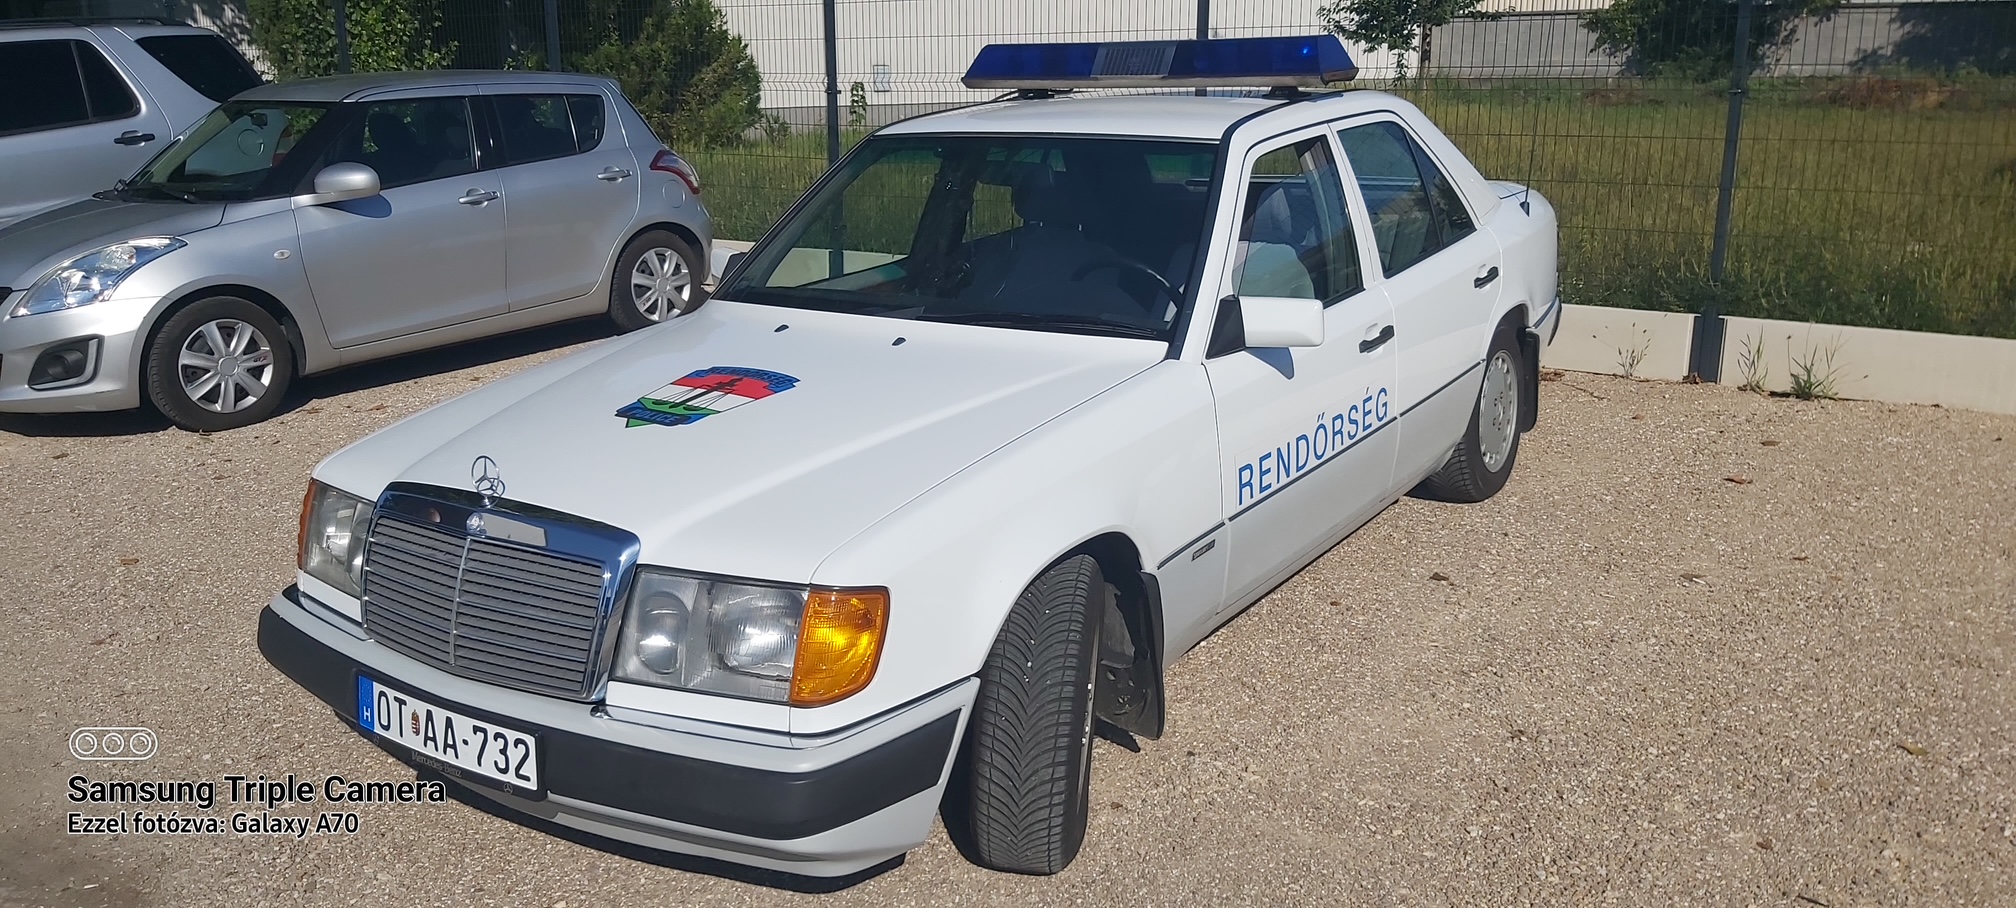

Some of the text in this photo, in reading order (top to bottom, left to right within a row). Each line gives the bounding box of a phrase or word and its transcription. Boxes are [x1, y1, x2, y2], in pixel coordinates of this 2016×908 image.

[627, 408, 678, 424] POLICE
[1238, 387, 1388, 506] RENDŐRSÉG
[363, 705, 371, 722] H
[377, 690, 531, 782] OT AA-732
[411, 750, 462, 777] Mercedes-Benz
